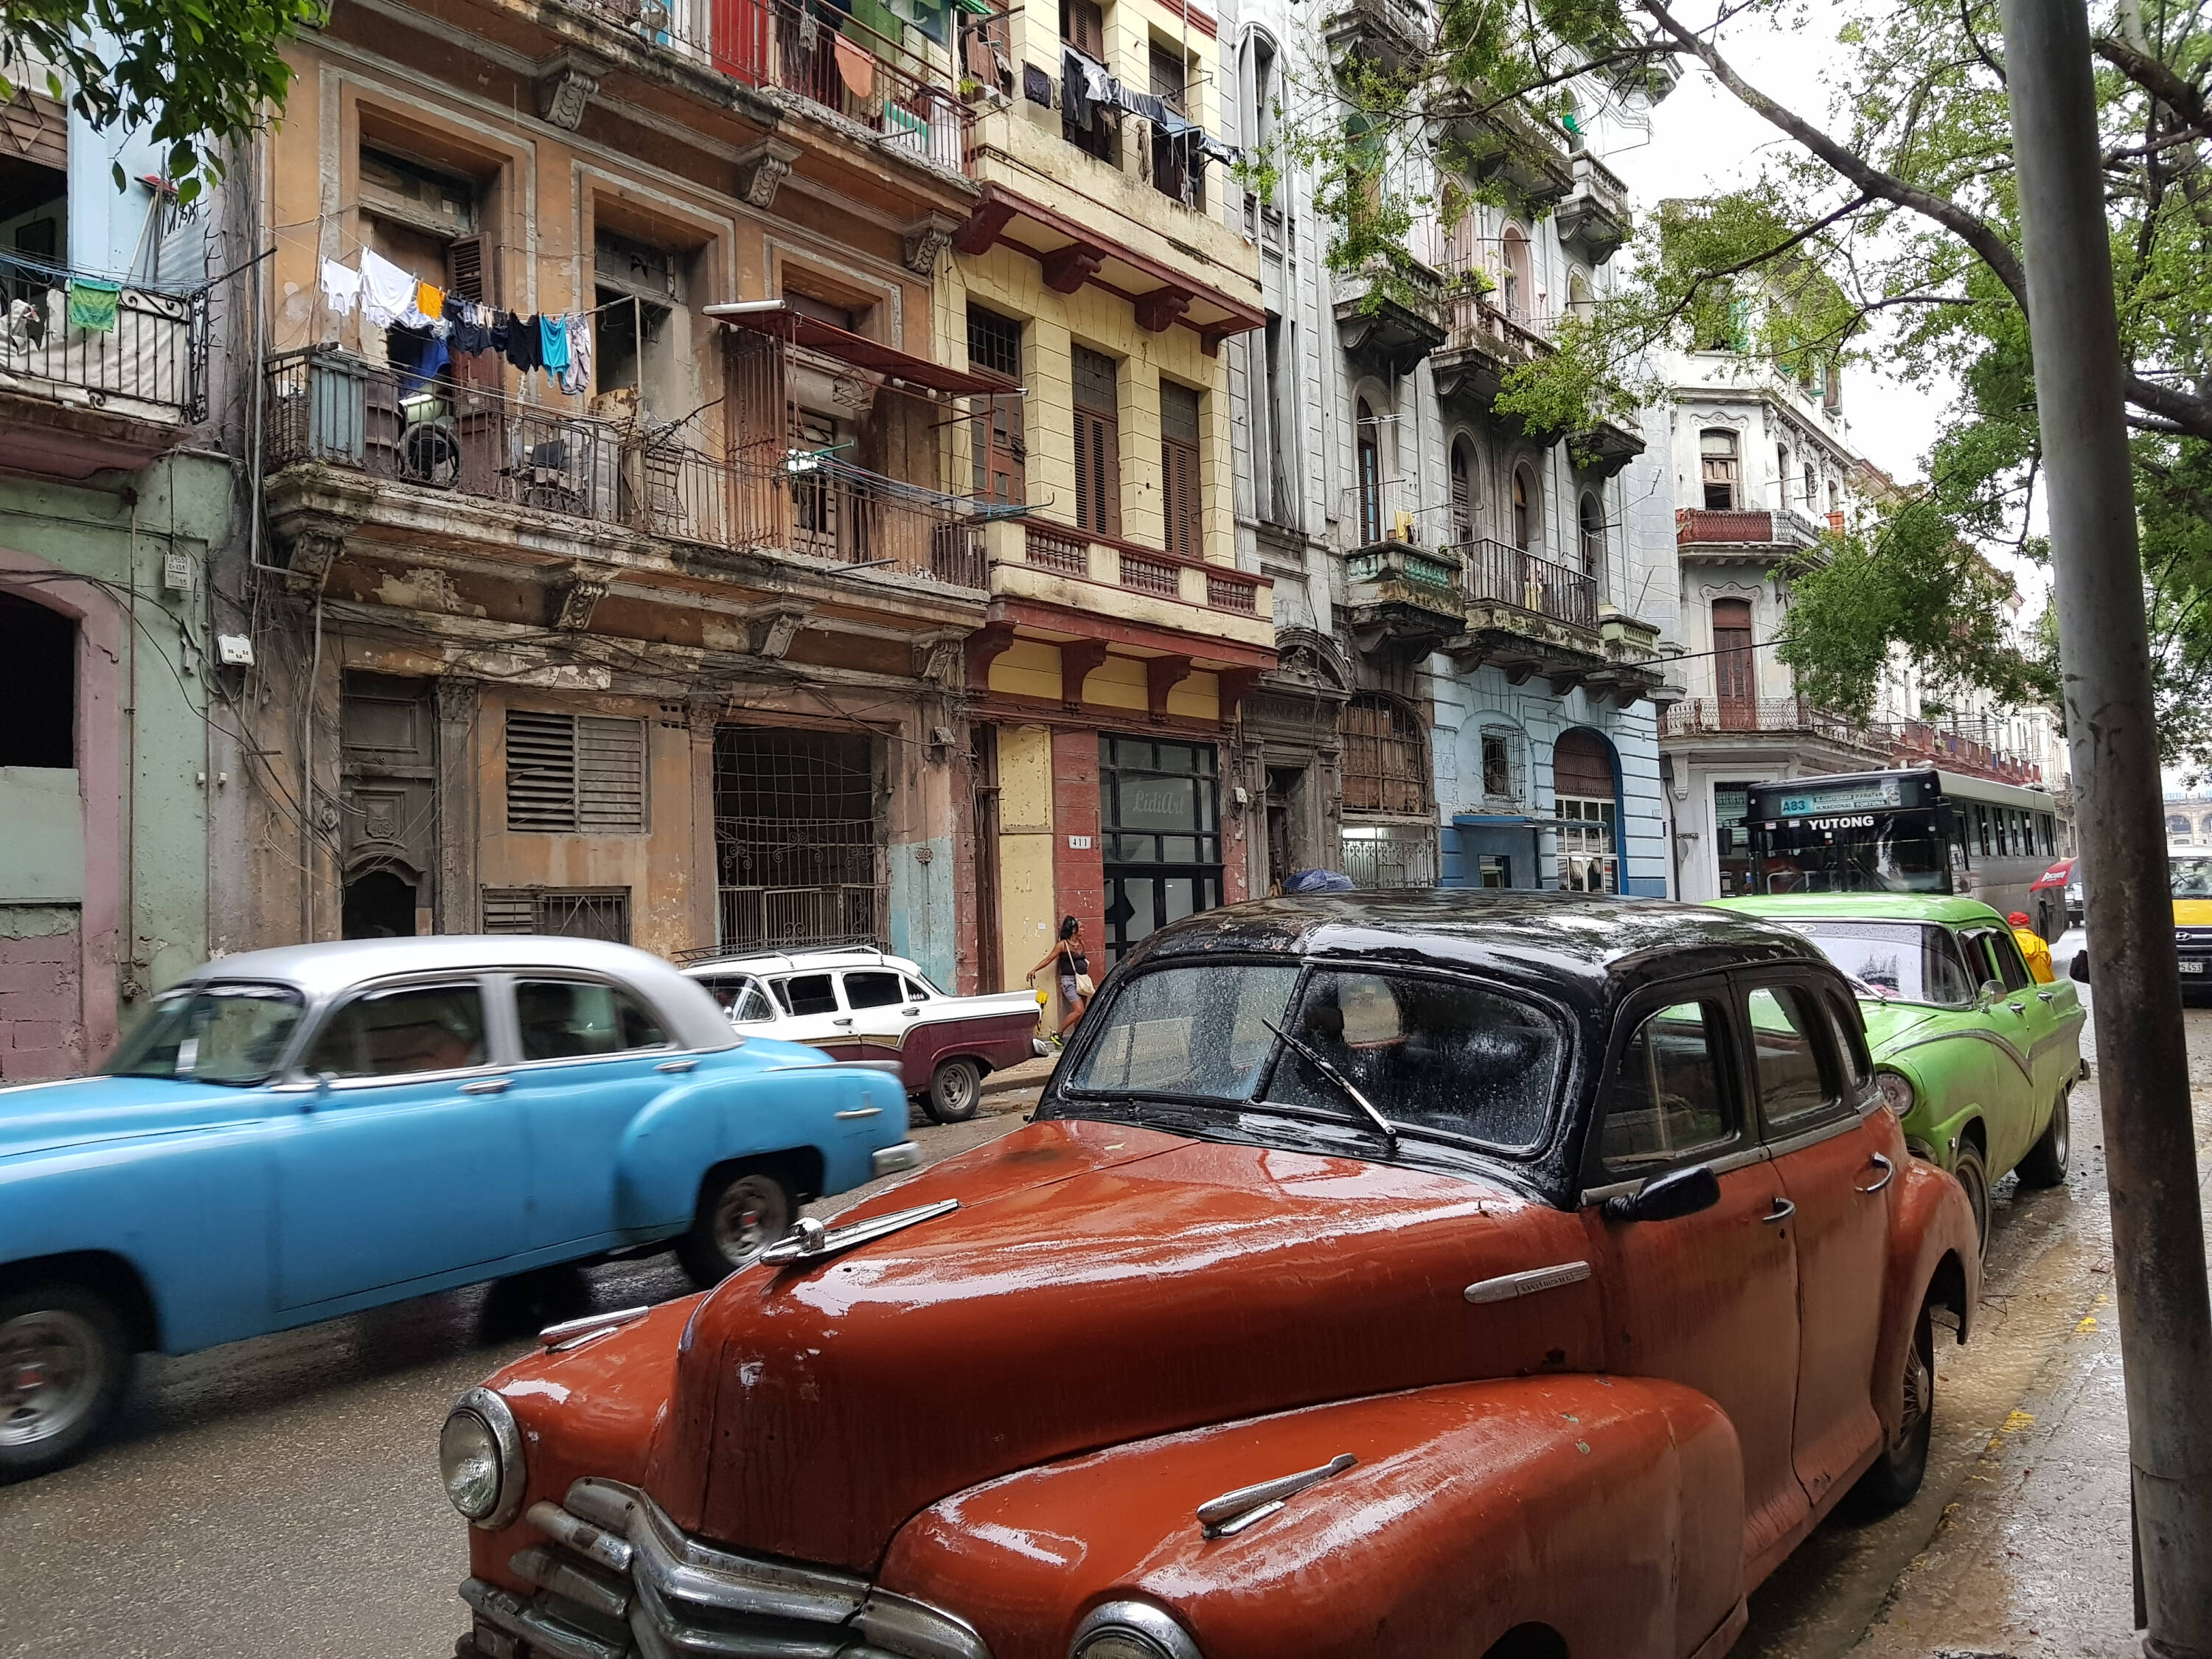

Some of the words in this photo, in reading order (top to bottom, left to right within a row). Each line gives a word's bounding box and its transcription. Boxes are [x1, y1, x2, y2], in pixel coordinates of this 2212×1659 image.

[1783, 801, 1806, 812] A83
[1808, 815, 1874, 830] YUTONG
[1072, 838, 1088, 846] 411
